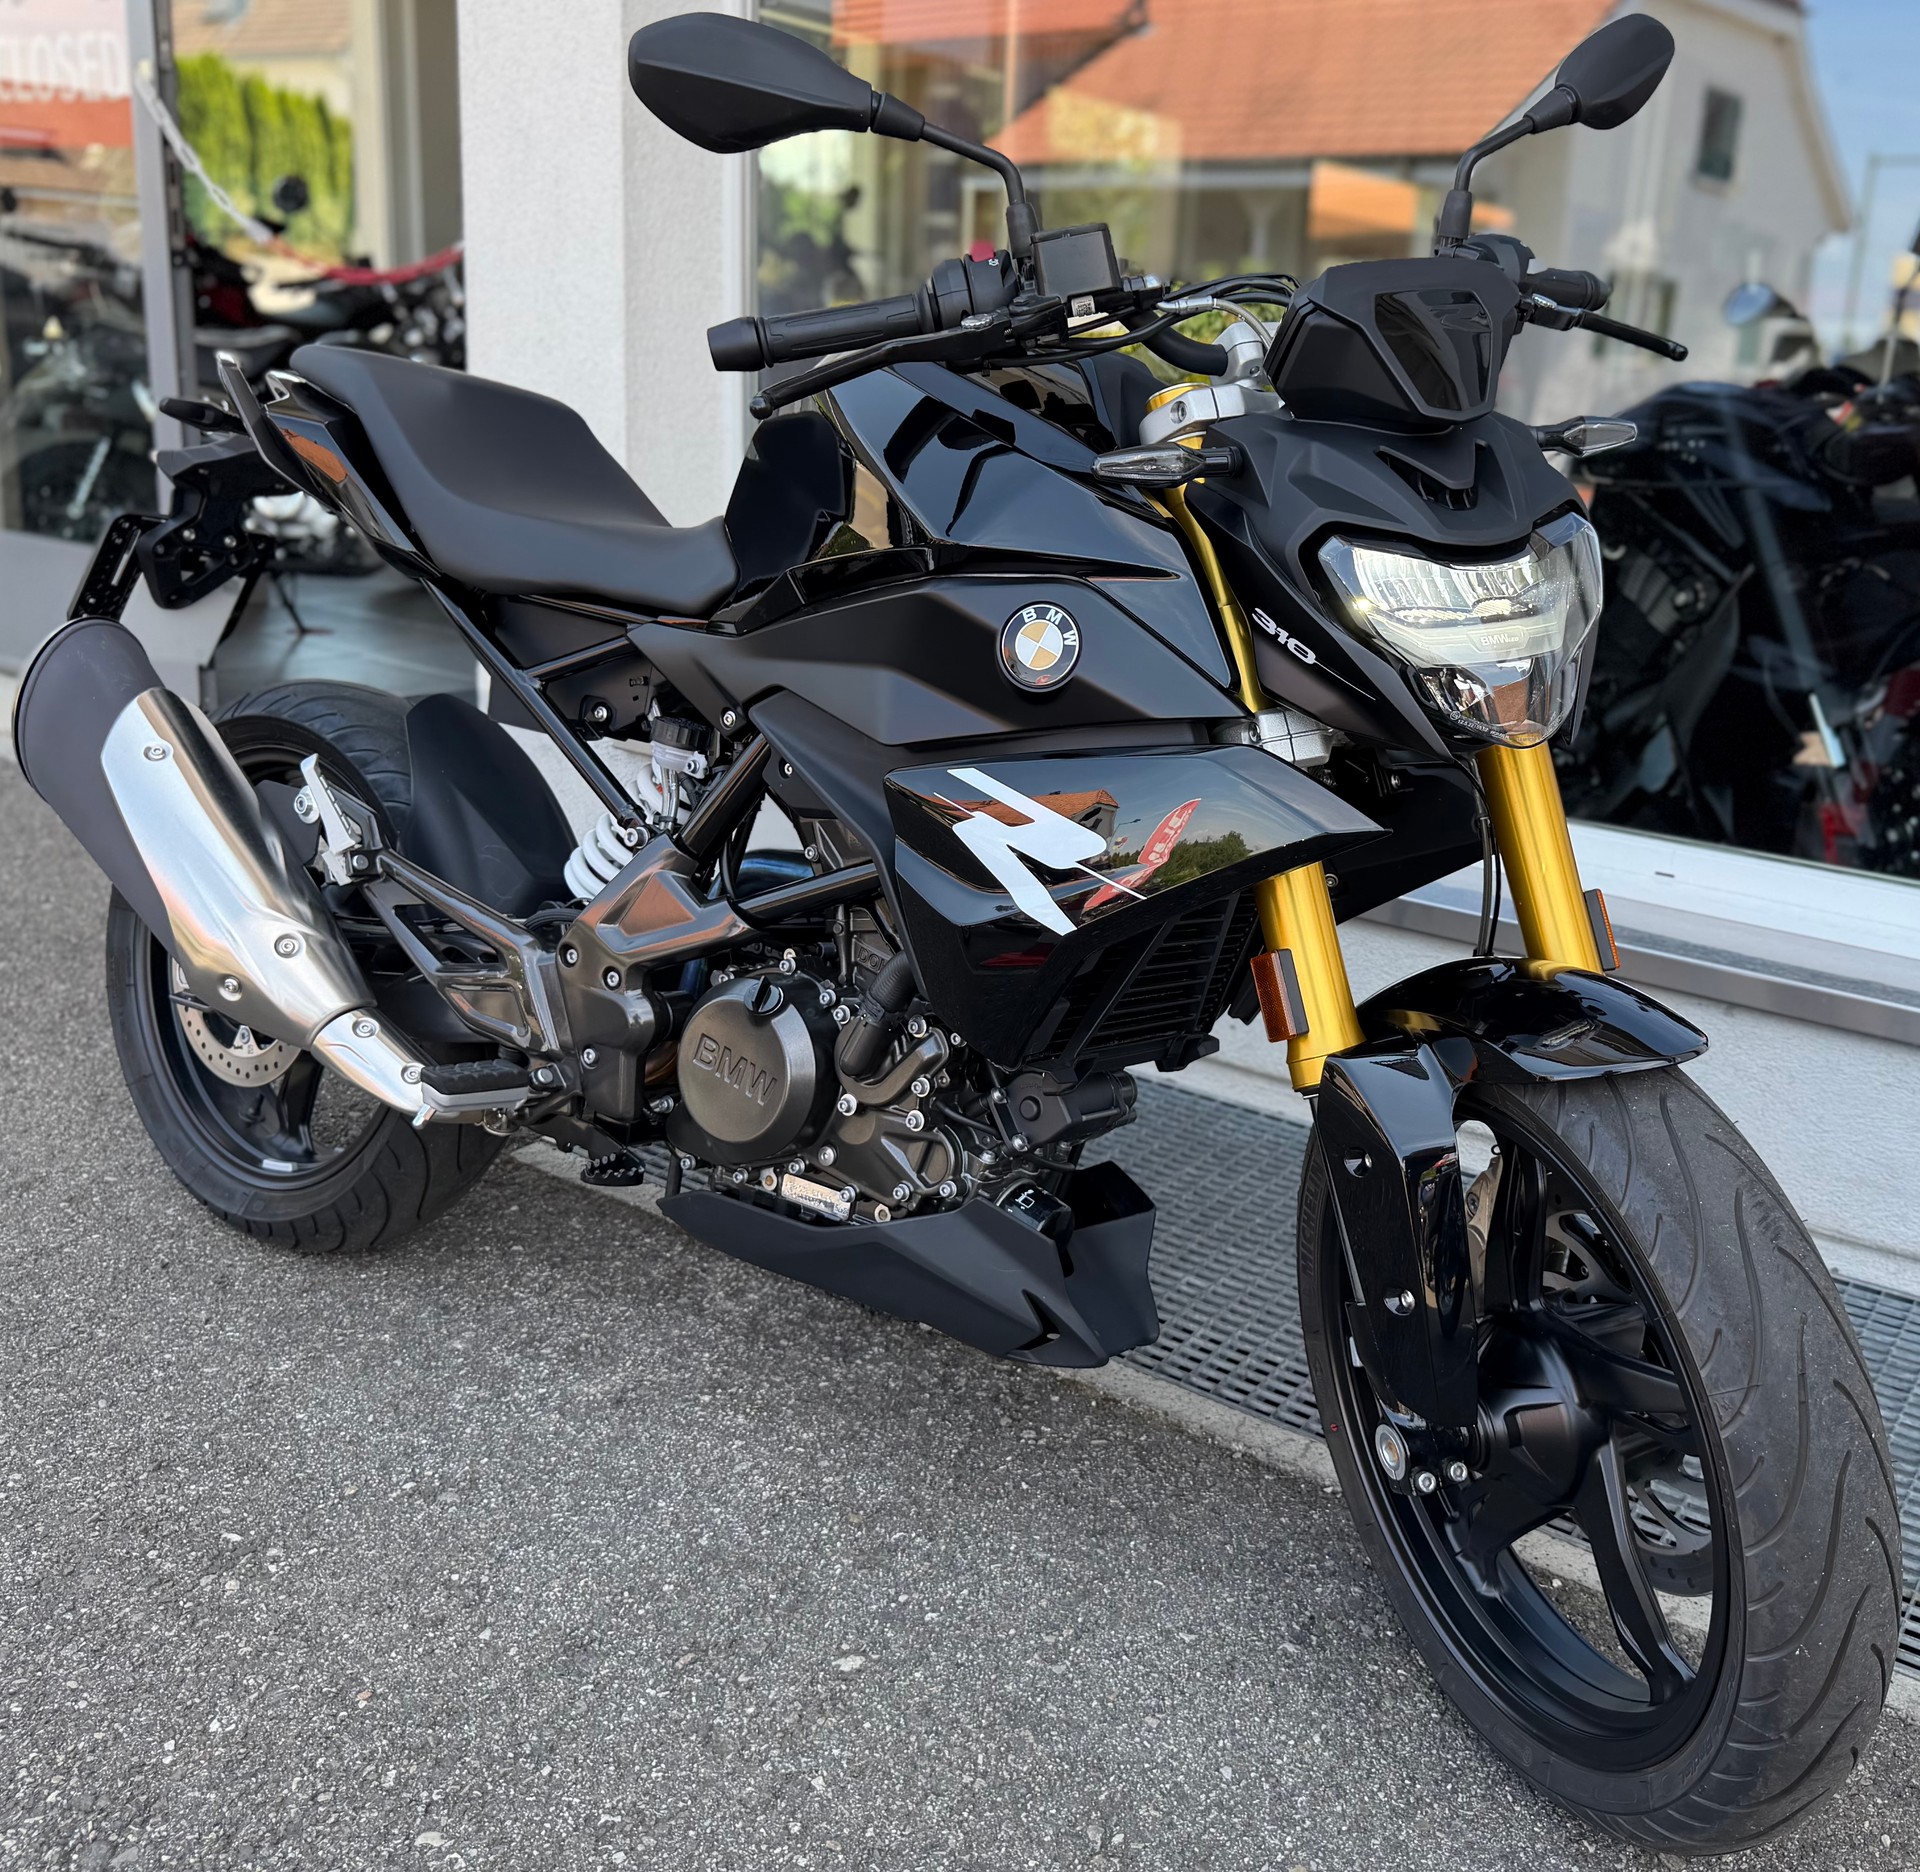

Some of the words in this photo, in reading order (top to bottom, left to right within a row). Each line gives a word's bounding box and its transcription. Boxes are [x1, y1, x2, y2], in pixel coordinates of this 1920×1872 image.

[1022, 608, 1077, 646] BMW
[1252, 608, 1316, 664] 310
[693, 1033, 777, 1106] BMW
[1300, 1158, 1322, 1278] MICHELIN
